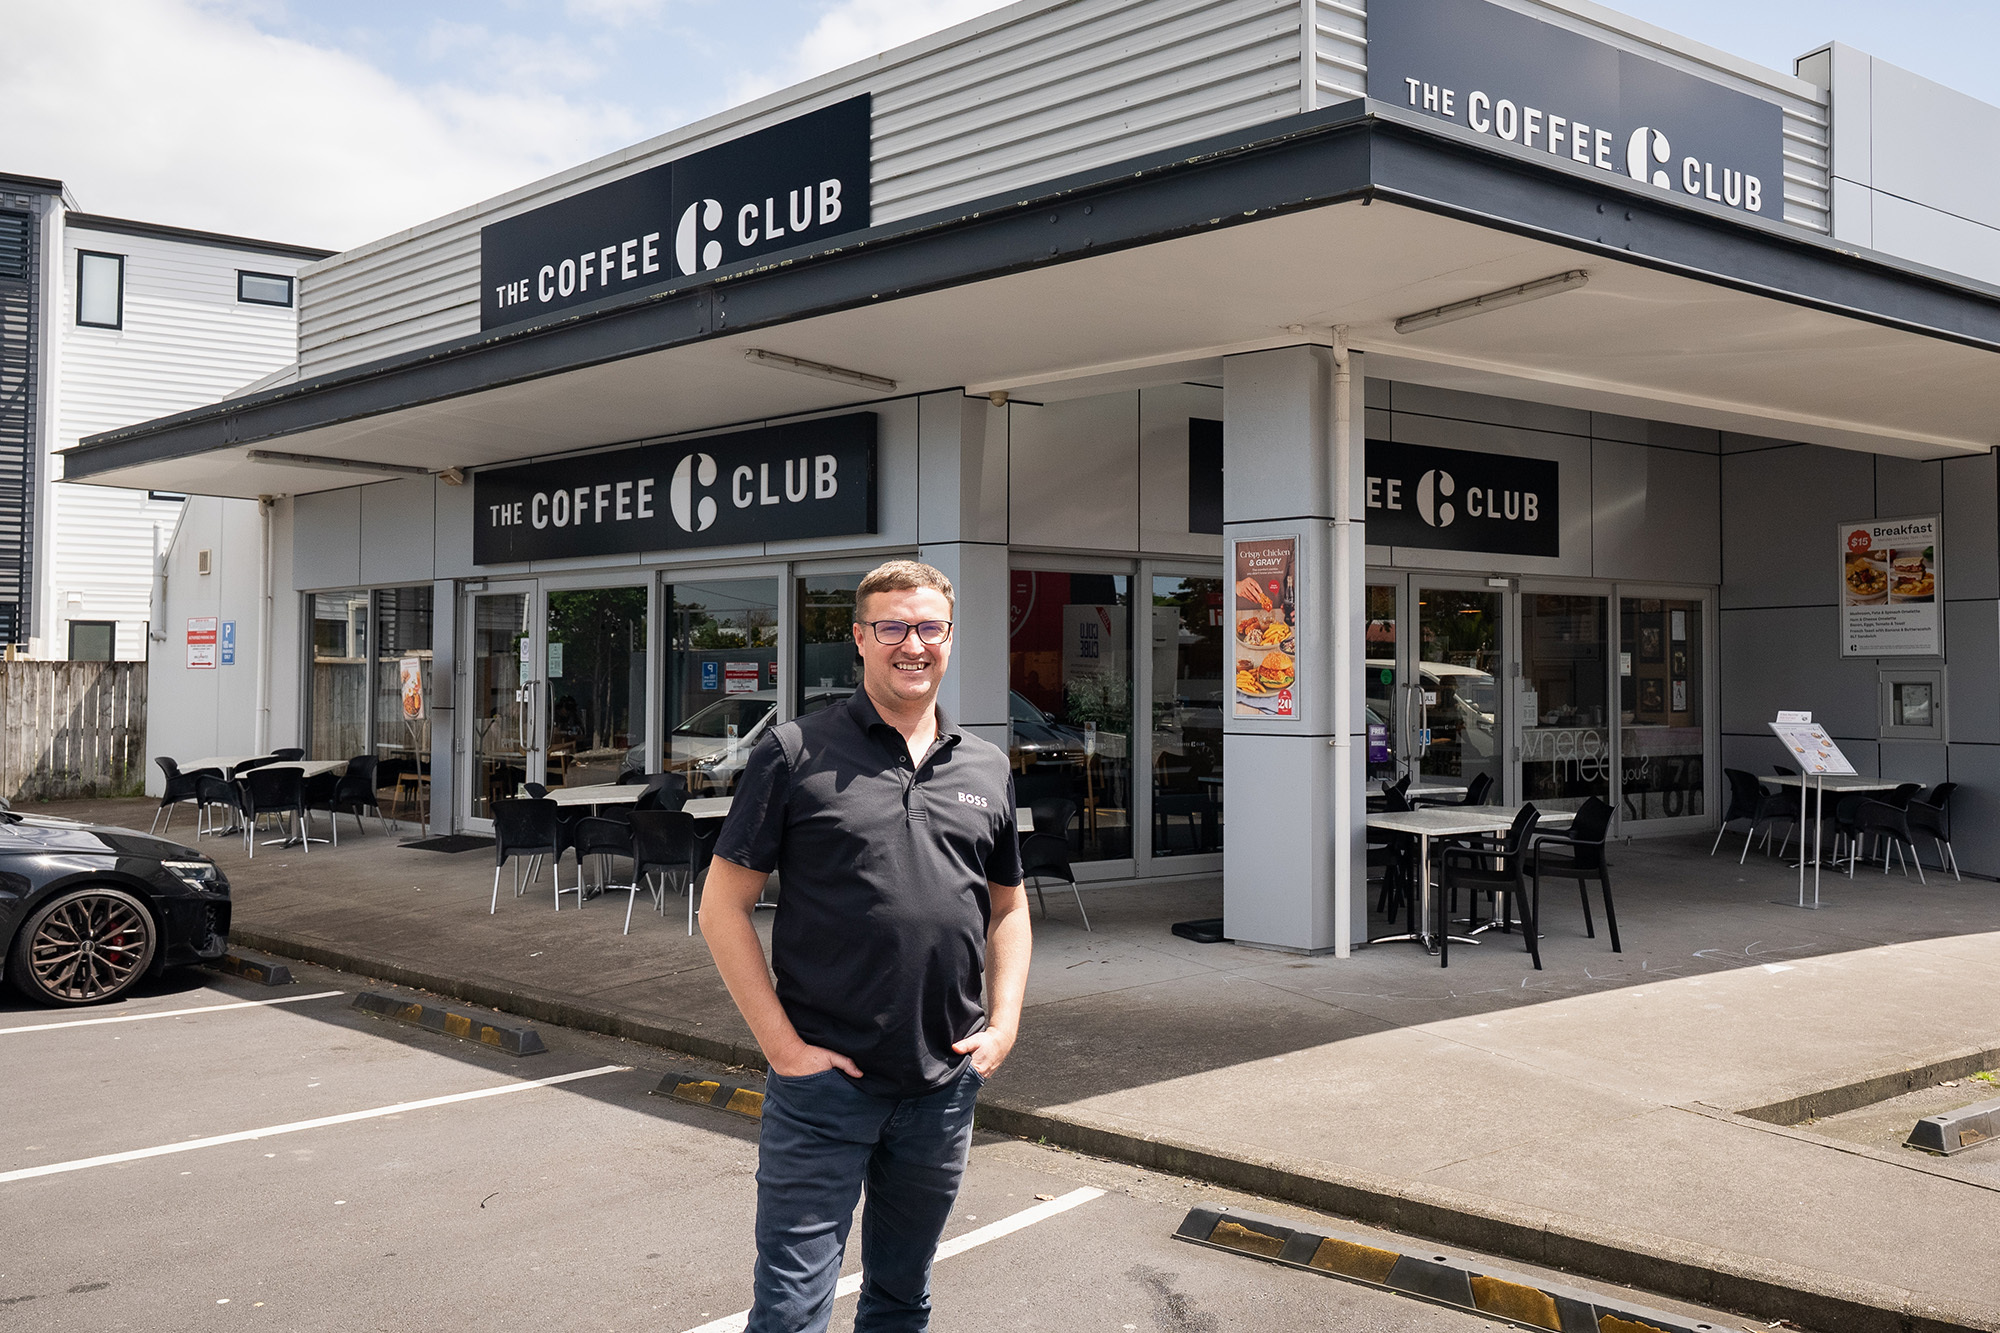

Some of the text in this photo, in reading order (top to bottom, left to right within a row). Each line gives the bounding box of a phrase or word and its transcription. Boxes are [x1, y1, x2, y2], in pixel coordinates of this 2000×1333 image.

[1404, 77, 1455, 118] THE
[1467, 90, 1613, 171] COFFEE
[1681, 156, 1762, 213] CLUB
[495, 278, 530, 309] THE
[538, 231, 661, 303] COFFEE
[737, 178, 843, 247] CLUB
[489, 502, 523, 528] THE
[531, 478, 655, 530] COFFEE
[732, 454, 838, 509] CLUB
[1467, 486, 1539, 522] CLUB
[1873, 523, 1933, 537] Breakfast
[1851, 537, 1869, 548] $15
[1240, 549, 1290, 559] Crispy Chicken
[1256, 558, 1282, 566] GRAVY
[225, 624, 231, 638] P
[1278, 699, 1292, 709] 20
[1370, 727, 1385, 736] FREE
[1553, 753, 1609, 782] mee
[1622, 753, 1648, 785] you?
[957, 791, 988, 808] BOSS
